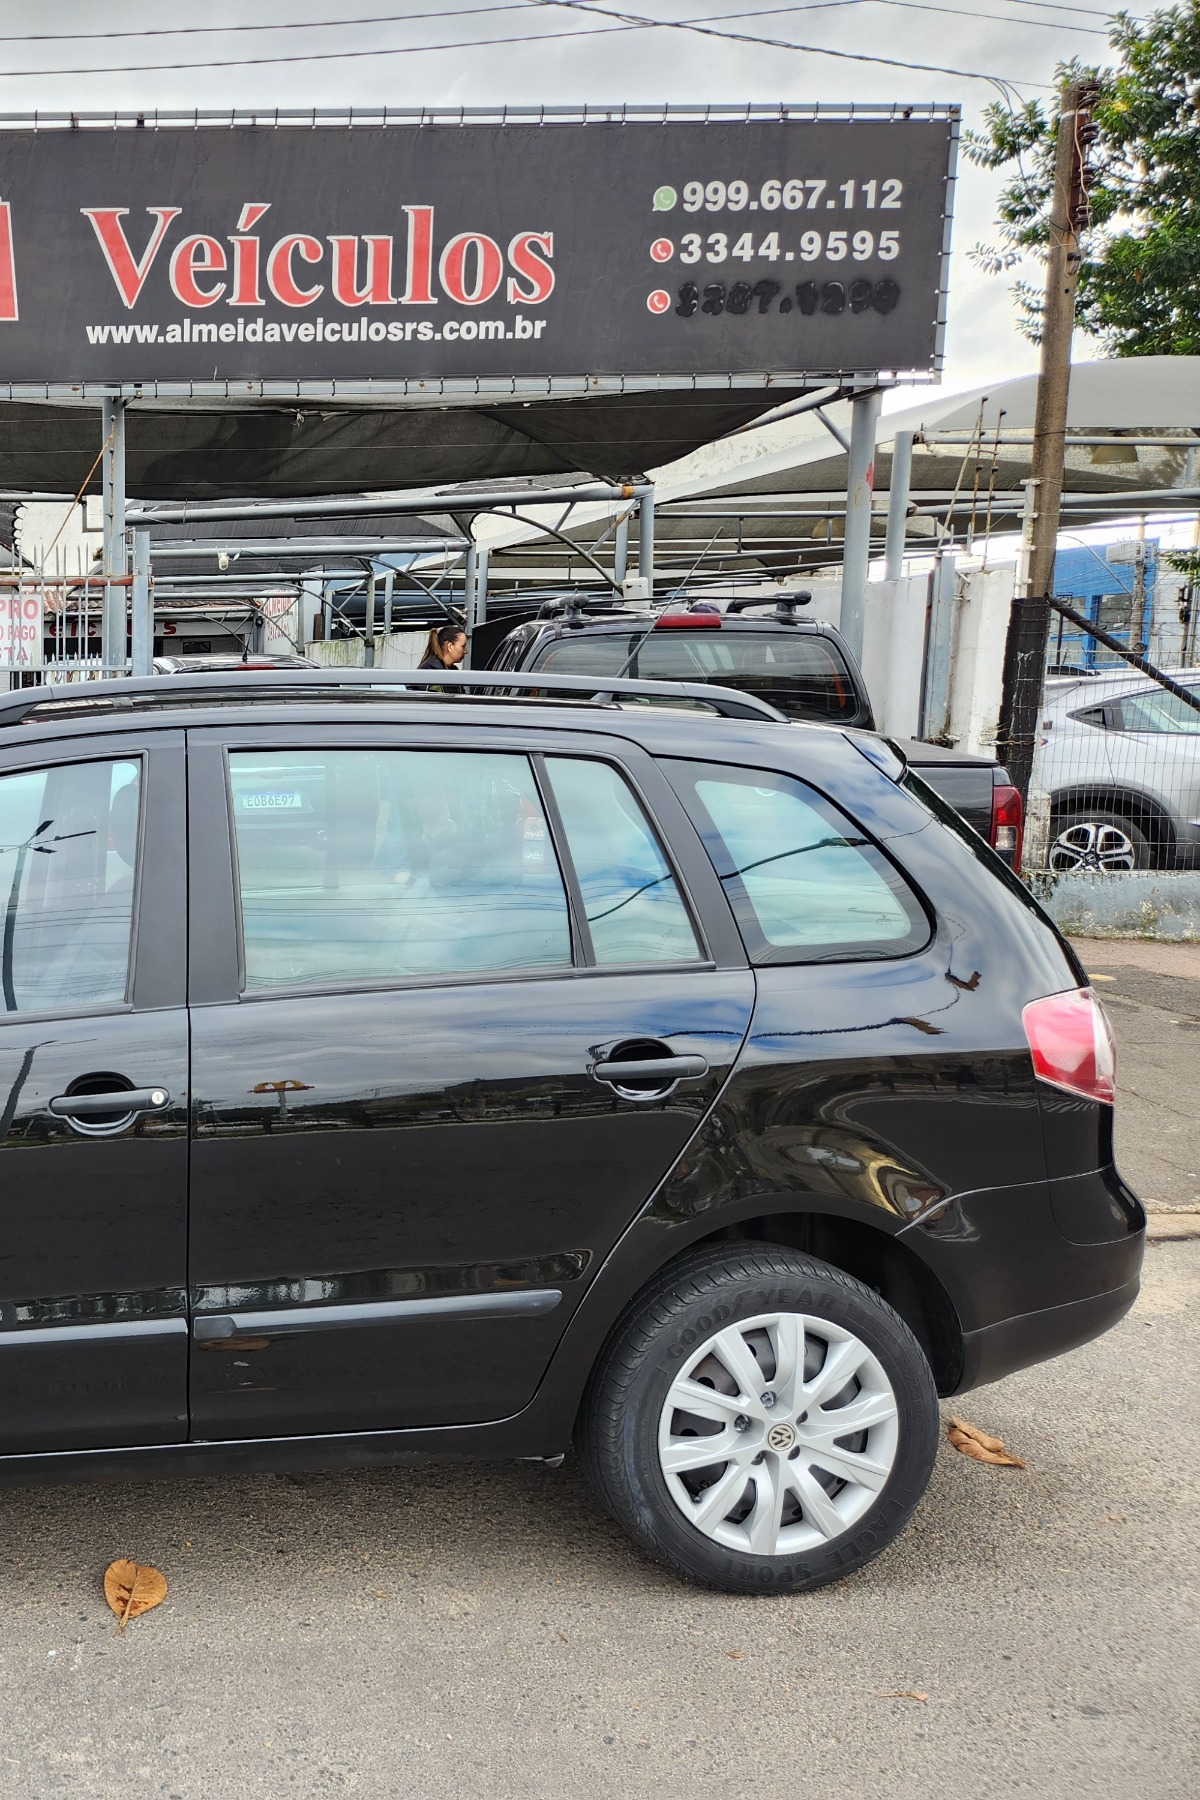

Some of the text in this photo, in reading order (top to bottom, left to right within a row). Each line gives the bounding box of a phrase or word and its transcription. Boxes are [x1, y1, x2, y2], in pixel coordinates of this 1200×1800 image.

[682, 179, 903, 212] 999.667.112
[80, 203, 556, 309] Veículos
[679, 230, 900, 264] 3344.9595
[85, 315, 547, 344] www.almeidaveiculosrs.com.br
